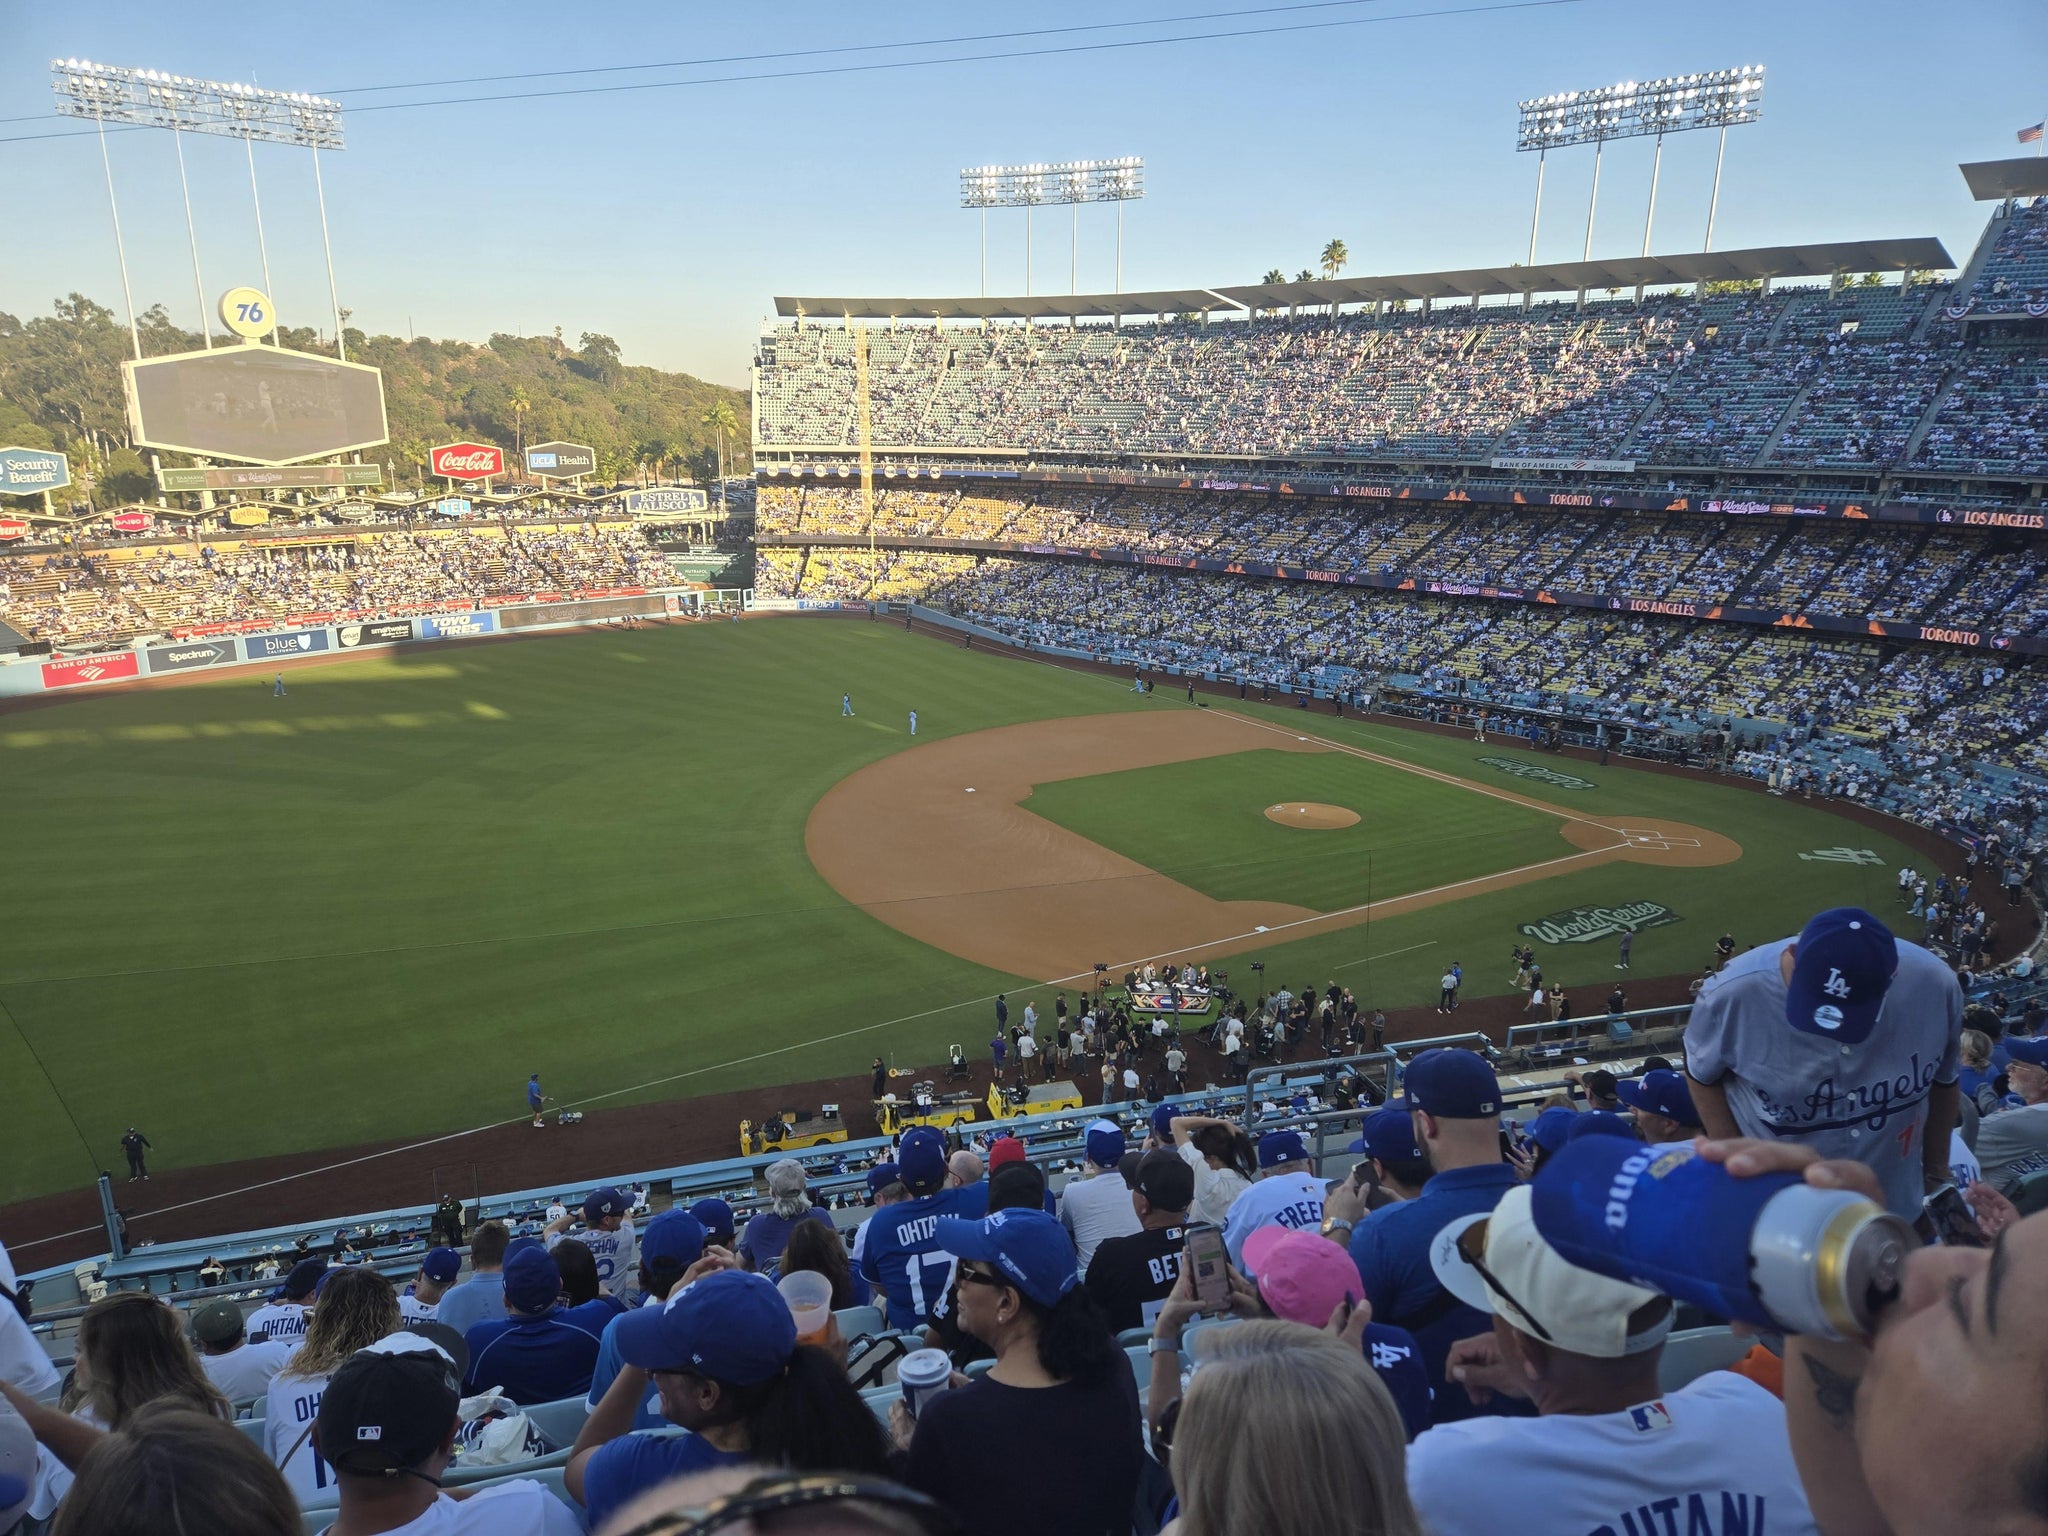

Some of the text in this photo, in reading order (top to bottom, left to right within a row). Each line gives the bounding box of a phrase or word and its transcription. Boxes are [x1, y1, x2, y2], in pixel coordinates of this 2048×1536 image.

[236, 301, 264, 323] 76
[6, 458, 59, 472] Security
[438, 451, 496, 471] Coca-Cola
[532, 455, 590, 466] UCLA Health
[9, 471, 57, 484] Benefit
[1346, 486, 1360, 496] LOS
[1360, 486, 1392, 498] ANGELES
[1549, 494, 1593, 506] TORONTO
[636, 501, 686, 511] JALISCO
[1722, 499, 1748, 512] World
[1746, 501, 1770, 515] Series
[1963, 510, 1988, 525] LOS
[1987, 512, 2045, 529] ANGELES
[1144, 554, 1155, 565] LOS
[1155, 555, 1182, 566] ANGELES
[1305, 570, 1340, 583] TORONTO
[1442, 582, 1462, 593] World
[1460, 584, 1480, 595] Series
[1630, 599, 1650, 612] LOS
[1650, 601, 1696, 616] ANGELES
[431, 616, 471, 628] TOYO
[438, 624, 481, 636] TIRES
[265, 636, 297, 651] blue
[1919, 626, 1980, 646] TORONTO
[51, 654, 127, 670] BANK OF AMERICA
[168, 649, 214, 663] Spectrum
[1523, 901, 1667, 944] World Series
[1823, 967, 1852, 999] LA
[1274, 1200, 1324, 1230] FREE
[896, 1213, 960, 1247] OHTA
[596, 1258, 615, 1282] 2
[905, 1249, 960, 1316] 17
[1371, 1342, 1411, 1369] LA
[1587, 1490, 1768, 1536] TANI
